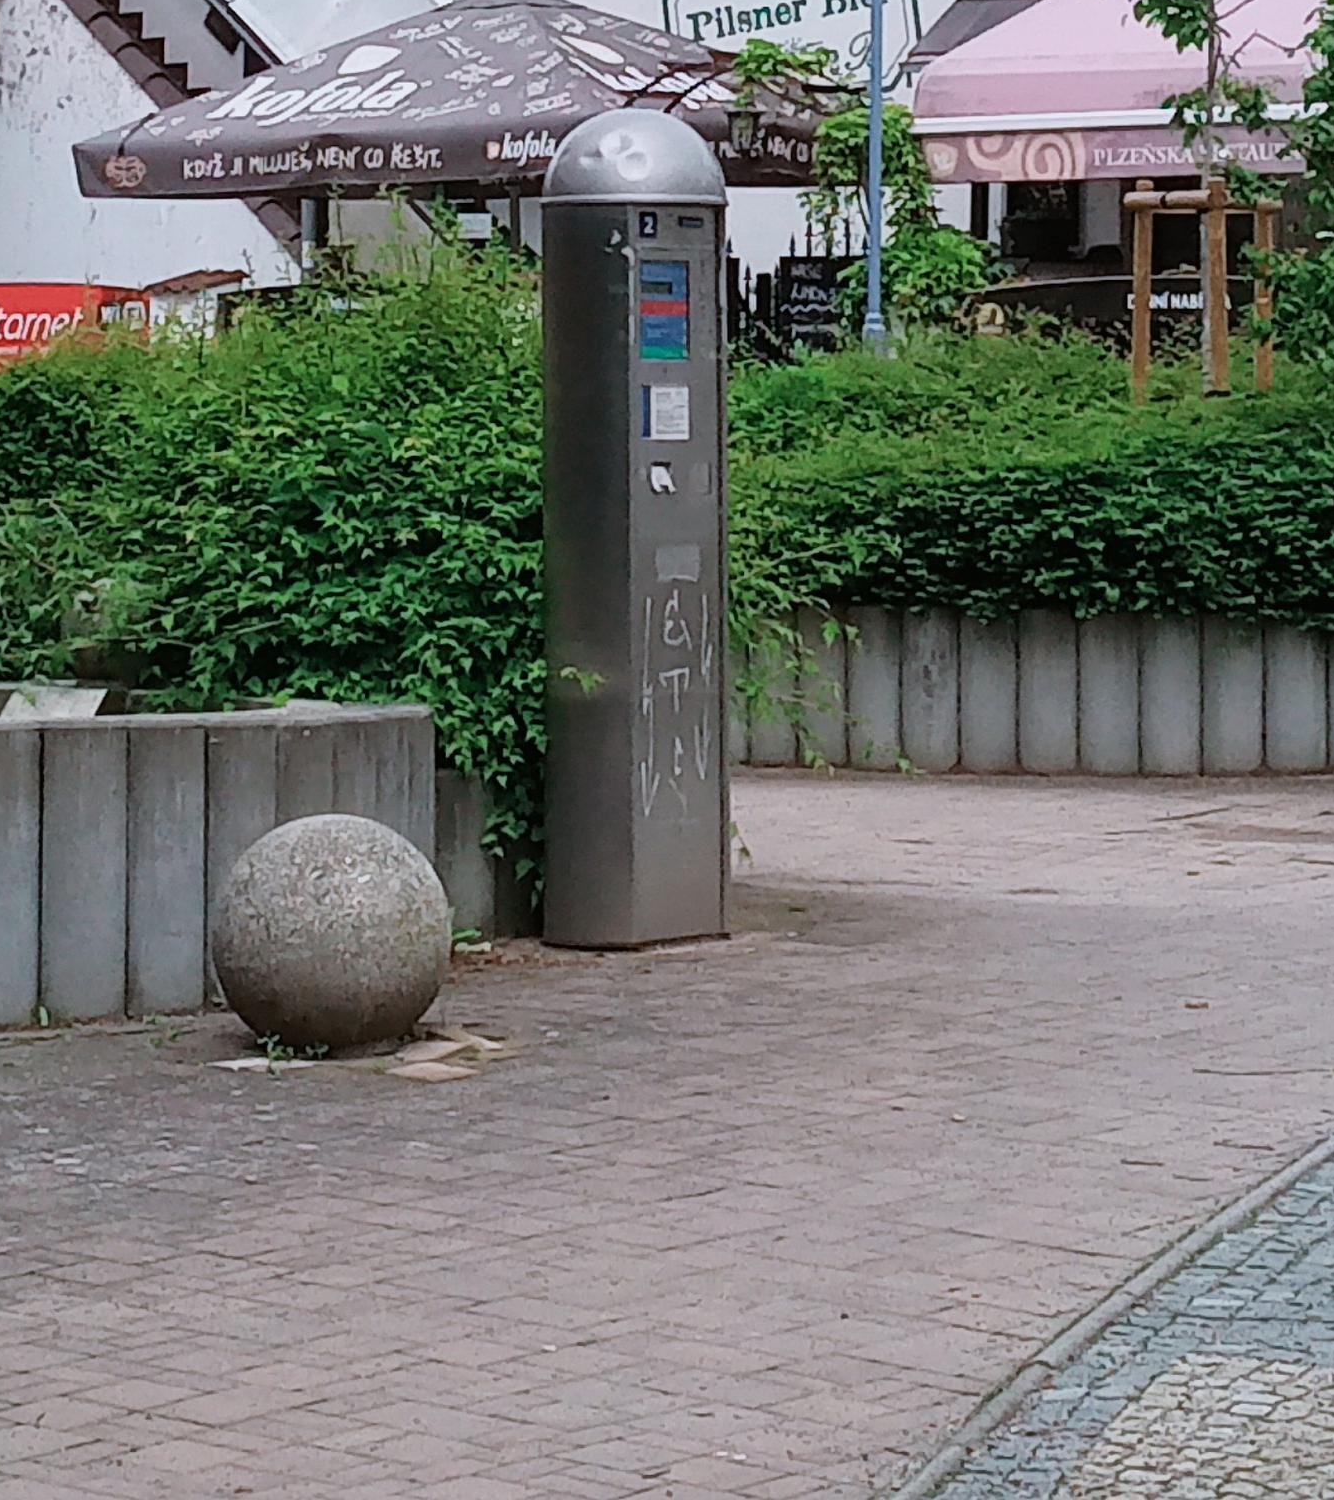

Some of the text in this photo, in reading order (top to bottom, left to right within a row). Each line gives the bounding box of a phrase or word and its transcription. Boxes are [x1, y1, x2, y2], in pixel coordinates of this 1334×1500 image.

[205, 68, 419, 128] kofola
[182, 153, 225, 180] KDYŽ
[363, 145, 383, 170] CO
[500, 130, 558, 167] kofola
[643, 215, 656, 235] 2
